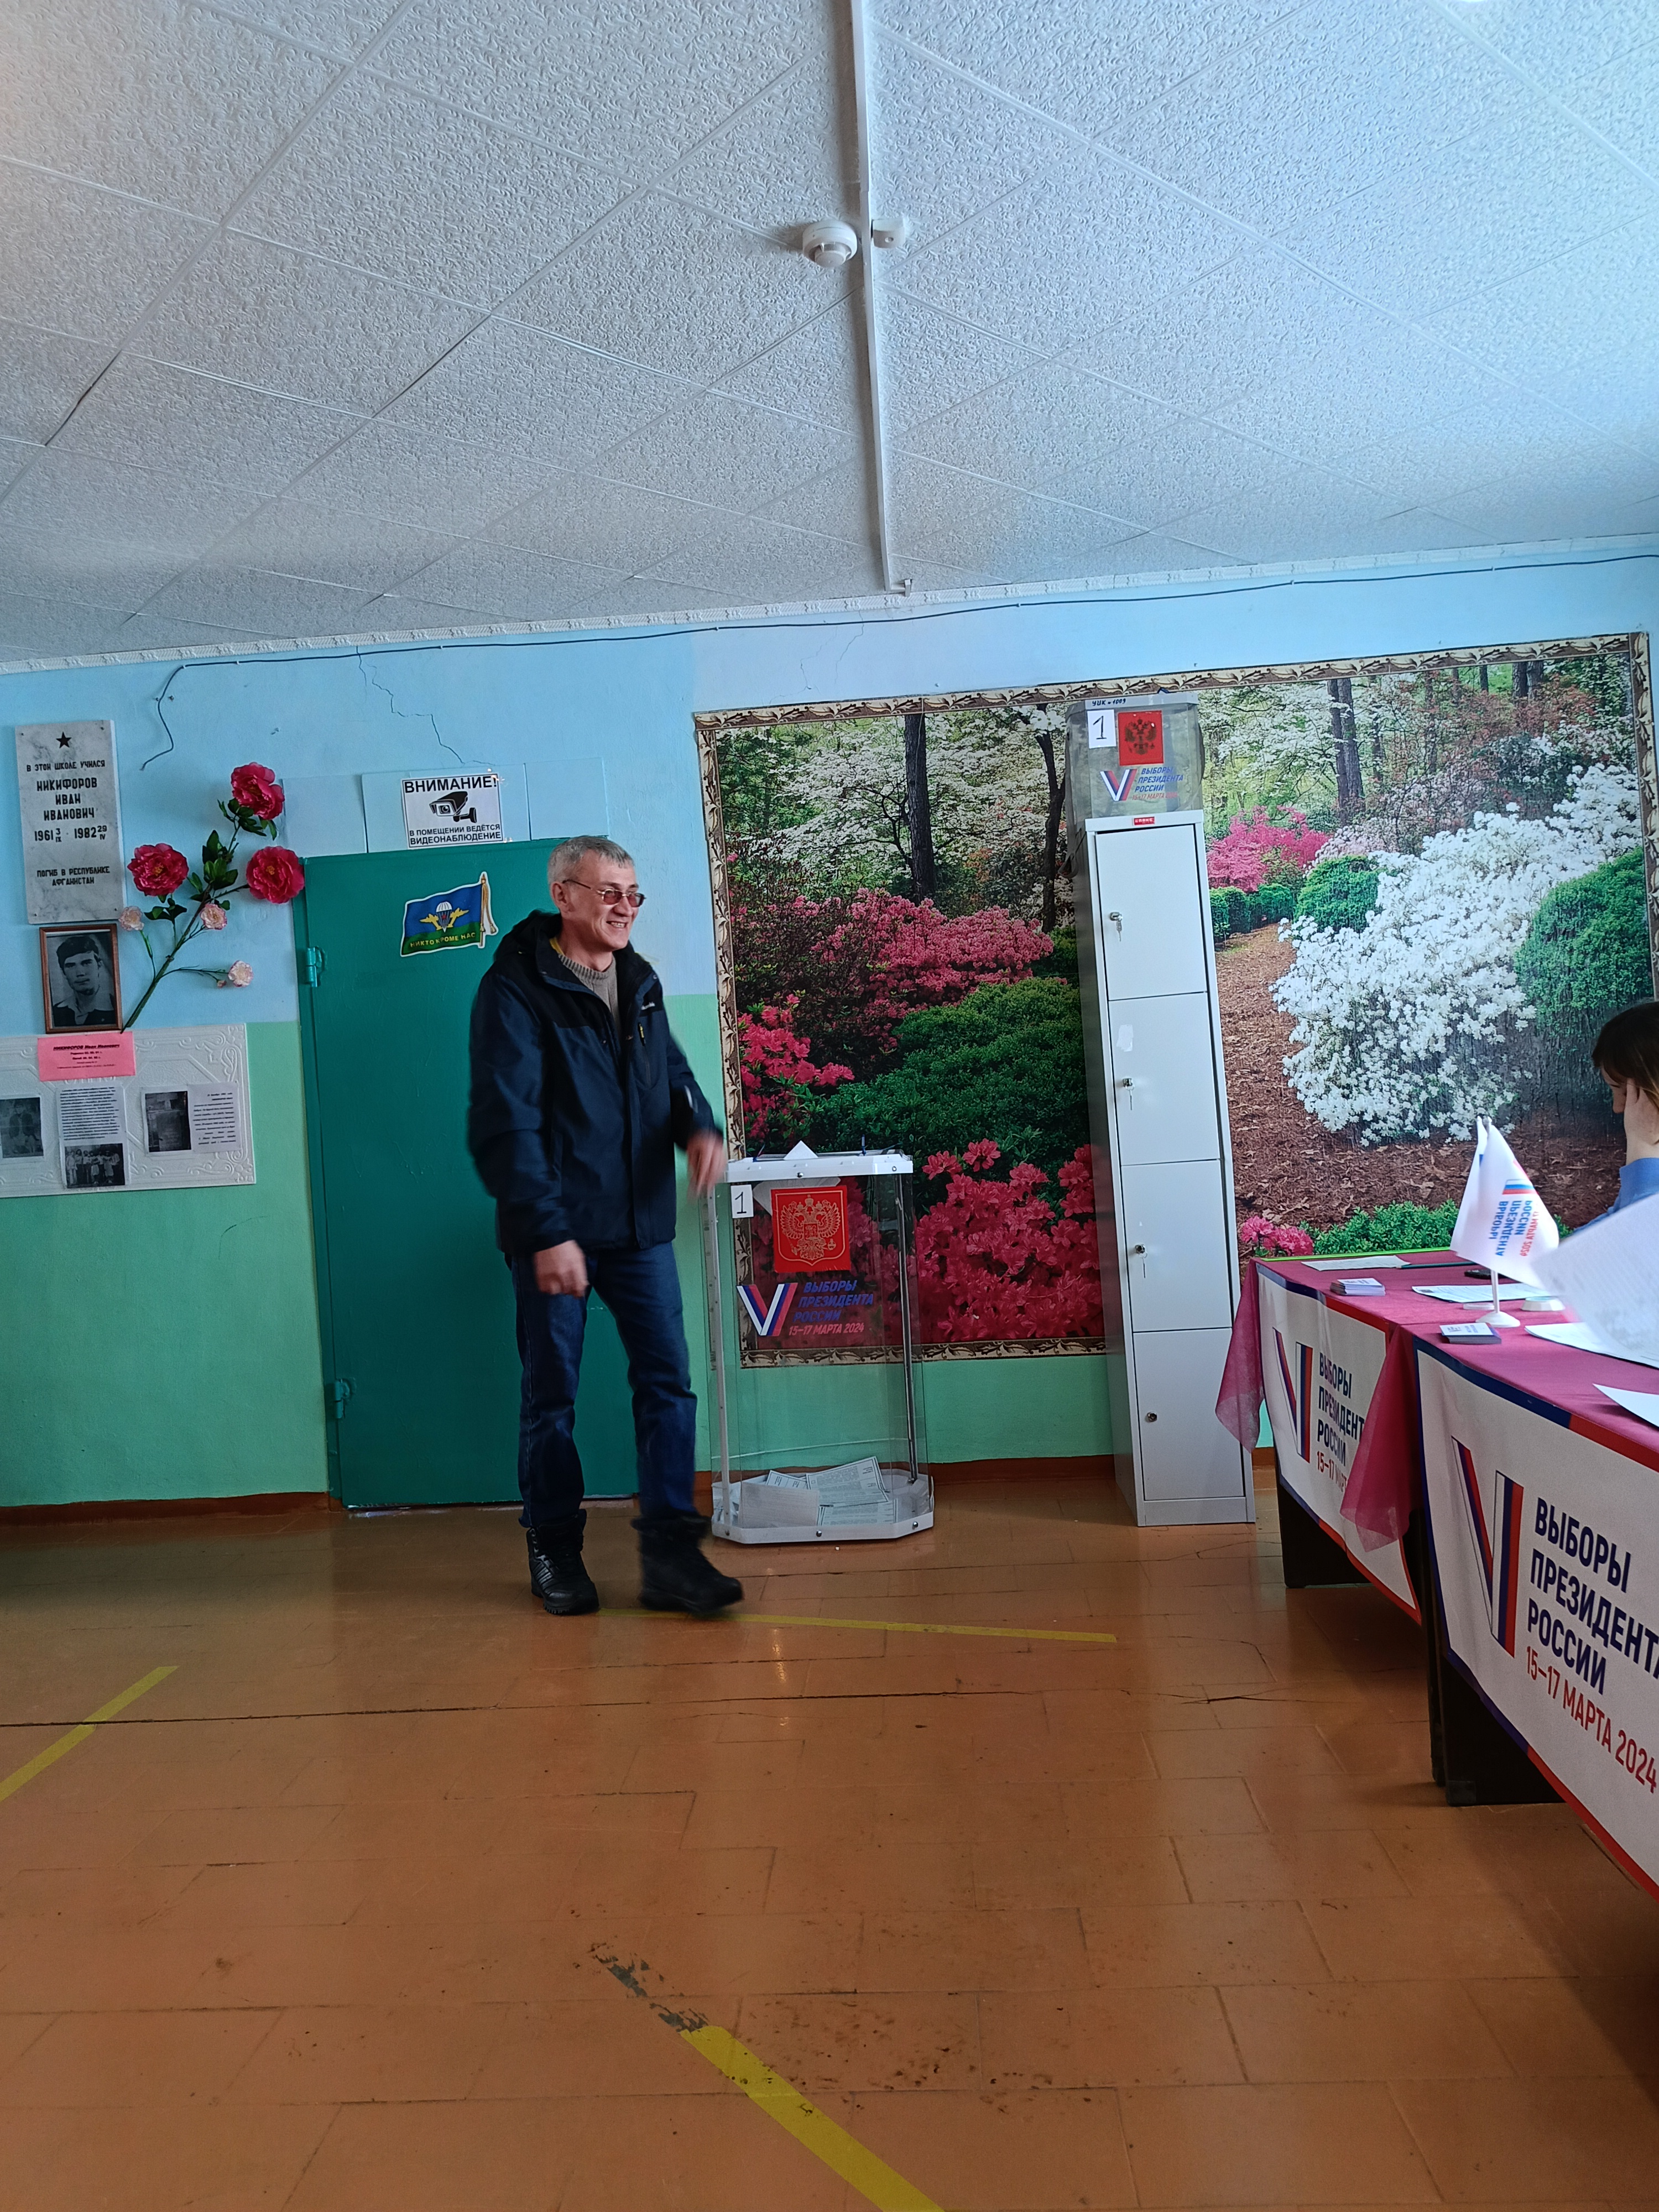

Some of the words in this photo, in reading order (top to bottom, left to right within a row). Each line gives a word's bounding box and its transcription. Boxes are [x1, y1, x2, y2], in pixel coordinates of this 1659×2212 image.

[1093, 715, 1107, 740] 1
[55, 761, 77, 770] ШКОЛЕ
[80, 760, 105, 768] УЧИЛСЯ
[1141, 766, 1173, 775] ВЫБОРЫ
[36, 778, 97, 791] НИКИФОРОВ
[404, 776, 497, 793] ВНИМАНИЕ!
[1138, 775, 1183, 784] ПРЕЗИДЕНТА
[55, 793, 81, 805] ИВАН
[44, 807, 95, 821] ИВАНОВИЧ
[35, 830, 54, 841] 1961
[74, 827, 97, 839] 1982
[416, 827, 465, 836] ПОМЕЩЕНИИ
[466, 824, 500, 832] ВЕДЁТСЯ
[410, 832, 501, 845] ВИДЕОНАБЛЮДЕНИЕ
[69, 866, 110, 875] РЕСПУБЛИКЕ
[52, 877, 95, 886] АФГАНИСТАН
[436, 936, 459, 944] КРОМЕ
[734, 1192, 747, 1214] 1
[804, 1280, 857, 1293] ВЫБОРЫ
[798, 1294, 873, 1308] ПРЕЗИДЕНТА
[793, 1310, 842, 1323] РОССИИ
[813, 1324, 842, 1334] МАРТА
[843, 1323, 864, 1333] 2024
[1319, 1352, 1352, 1399] ВЫБОРЫ
[1319, 1386, 1365, 1442] ПРЕЗИДЕНТ
[1317, 1418, 1346, 1467] РОССИИ
[1335, 1464, 1348, 1493] МАРТ
[1535, 1497, 1631, 1593] ВЫБОРЫ
[1530, 1548, 1659, 1679] ПРЕЗИДЕНТ
[1527, 1598, 1606, 1695] РОССИИ
[1563, 1679, 1611, 1754] МАРТА
[1615, 1729, 1657, 1794] 2024
